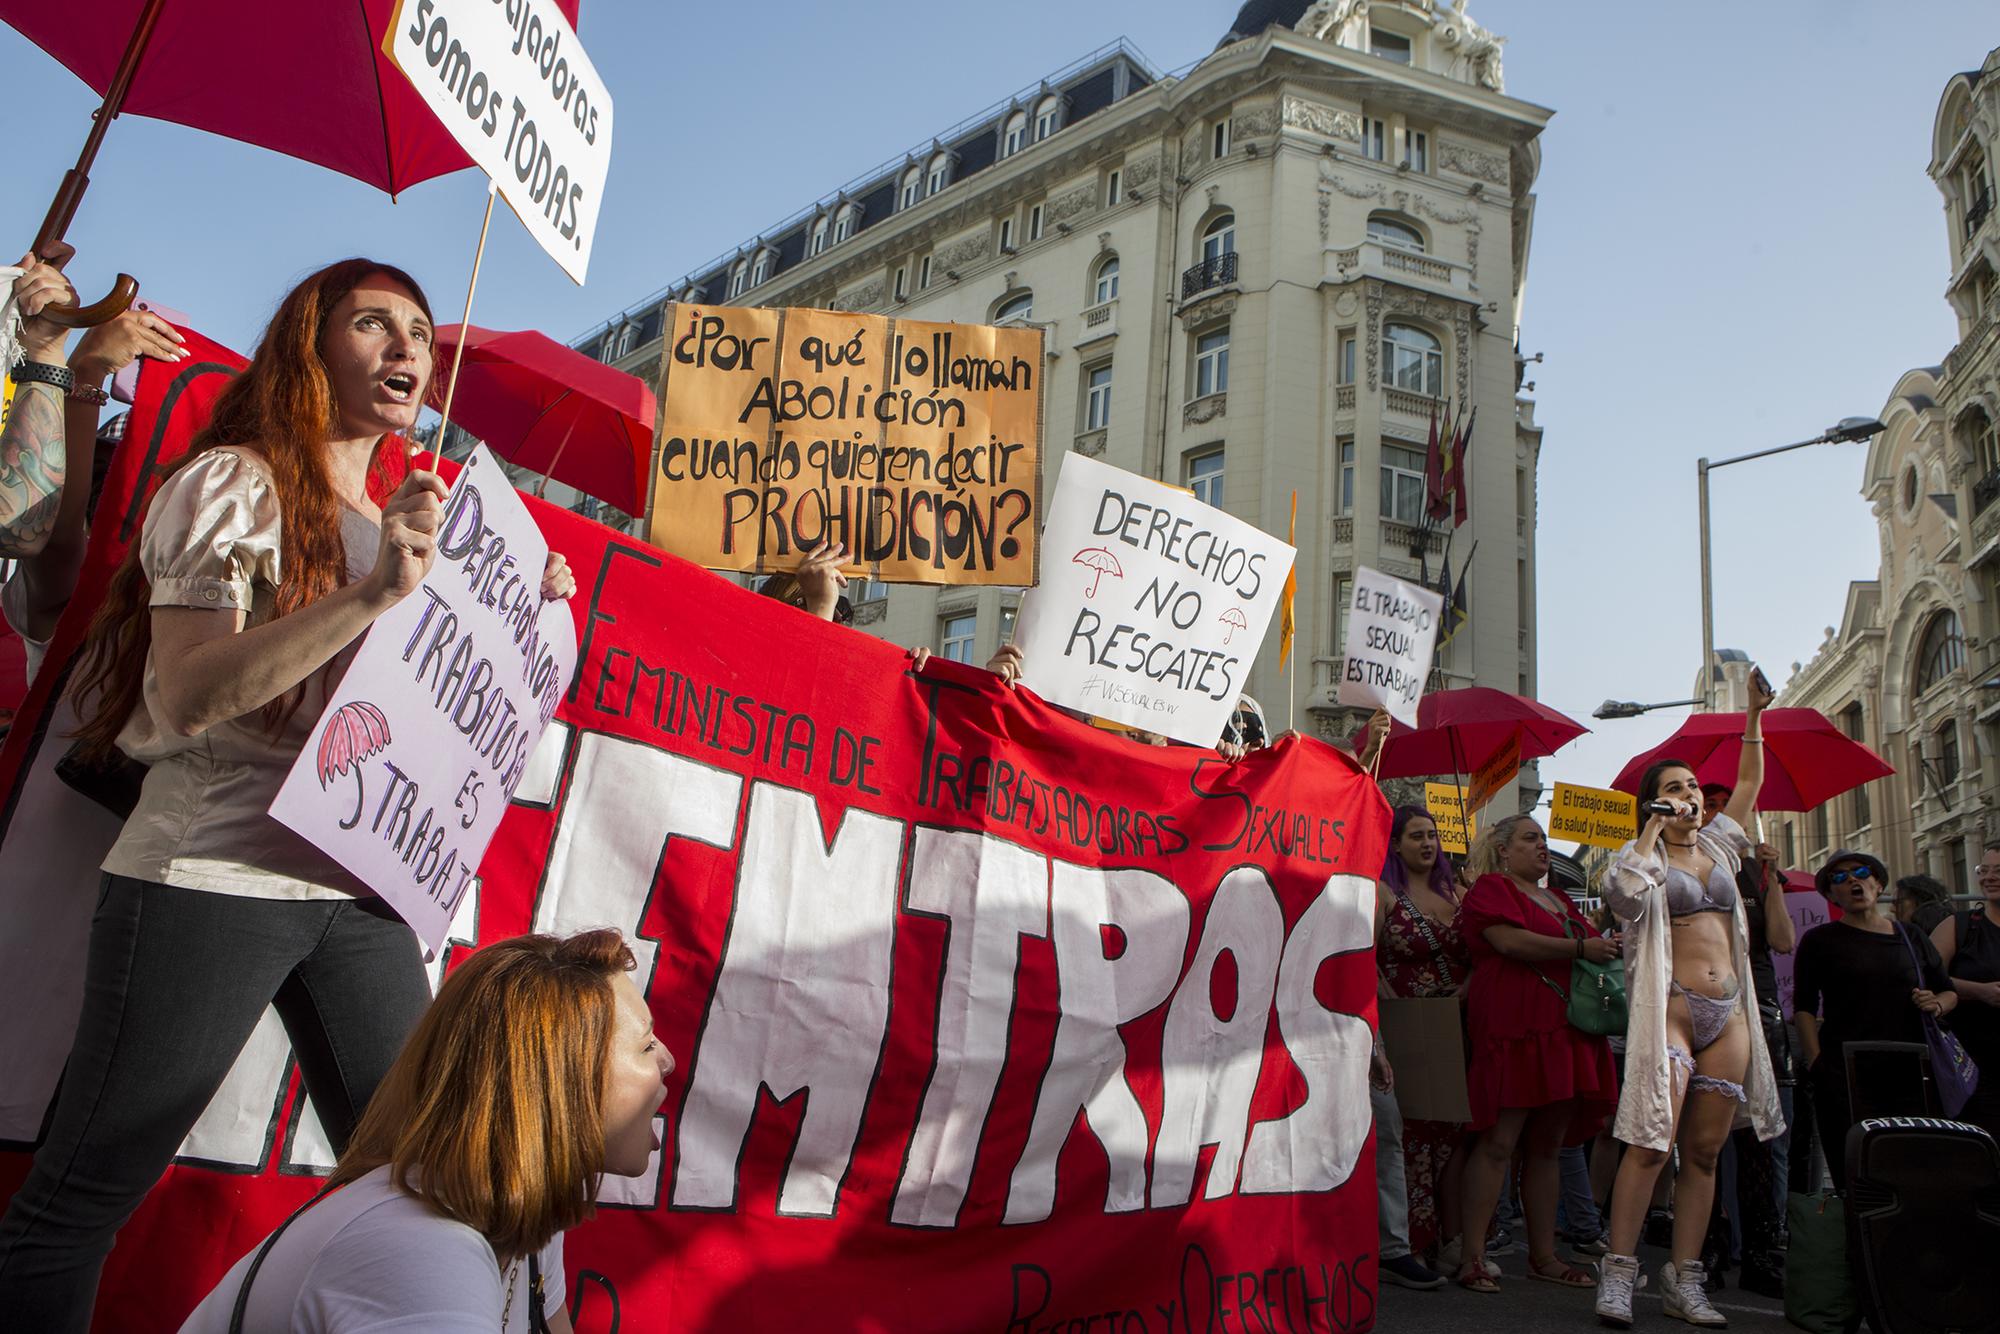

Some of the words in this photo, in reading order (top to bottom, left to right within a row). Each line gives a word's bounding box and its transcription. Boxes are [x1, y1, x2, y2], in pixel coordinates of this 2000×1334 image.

[490, 0, 598, 146] ajadoras
[409, 0, 503, 138] somos
[504, 96, 583, 252] TODAS.
[674, 310, 770, 371] ¿Por
[799, 327, 866, 373] qué
[661, 431, 800, 485] cuando
[721, 484, 1032, 571] PROHIBICIÓN?
[1092, 488, 1267, 600] DERECHOS
[1134, 576, 1202, 630] NO
[1354, 586, 1371, 612] EL
[1372, 591, 1432, 634] TRABAJO
[1063, 607, 1239, 701] RESCATES
[1365, 624, 1417, 663] SEXUAL
[404, 583, 519, 771] TRABAJO
[567, 540, 818, 776] FEMINISTA
[828, 726, 882, 797] DE
[903, 669, 1190, 857] TRABAJADORAS
[1190, 757, 1346, 865] SEXUALES
[1346, 657, 1363, 682] ES
[1365, 660, 1420, 705] TRABAJO
[454, 768, 485, 830] ES
[1552, 813, 1563, 831] da
[1564, 815, 1588, 834] salud
[1588, 820, 1596, 840] y
[1596, 818, 1635, 841] bienestar
[1562, 789, 1573, 807] El
[1573, 792, 1603, 814] trabajo
[1603, 799, 1632, 815] sexual
[371, 759, 473, 922] TRABAJ
